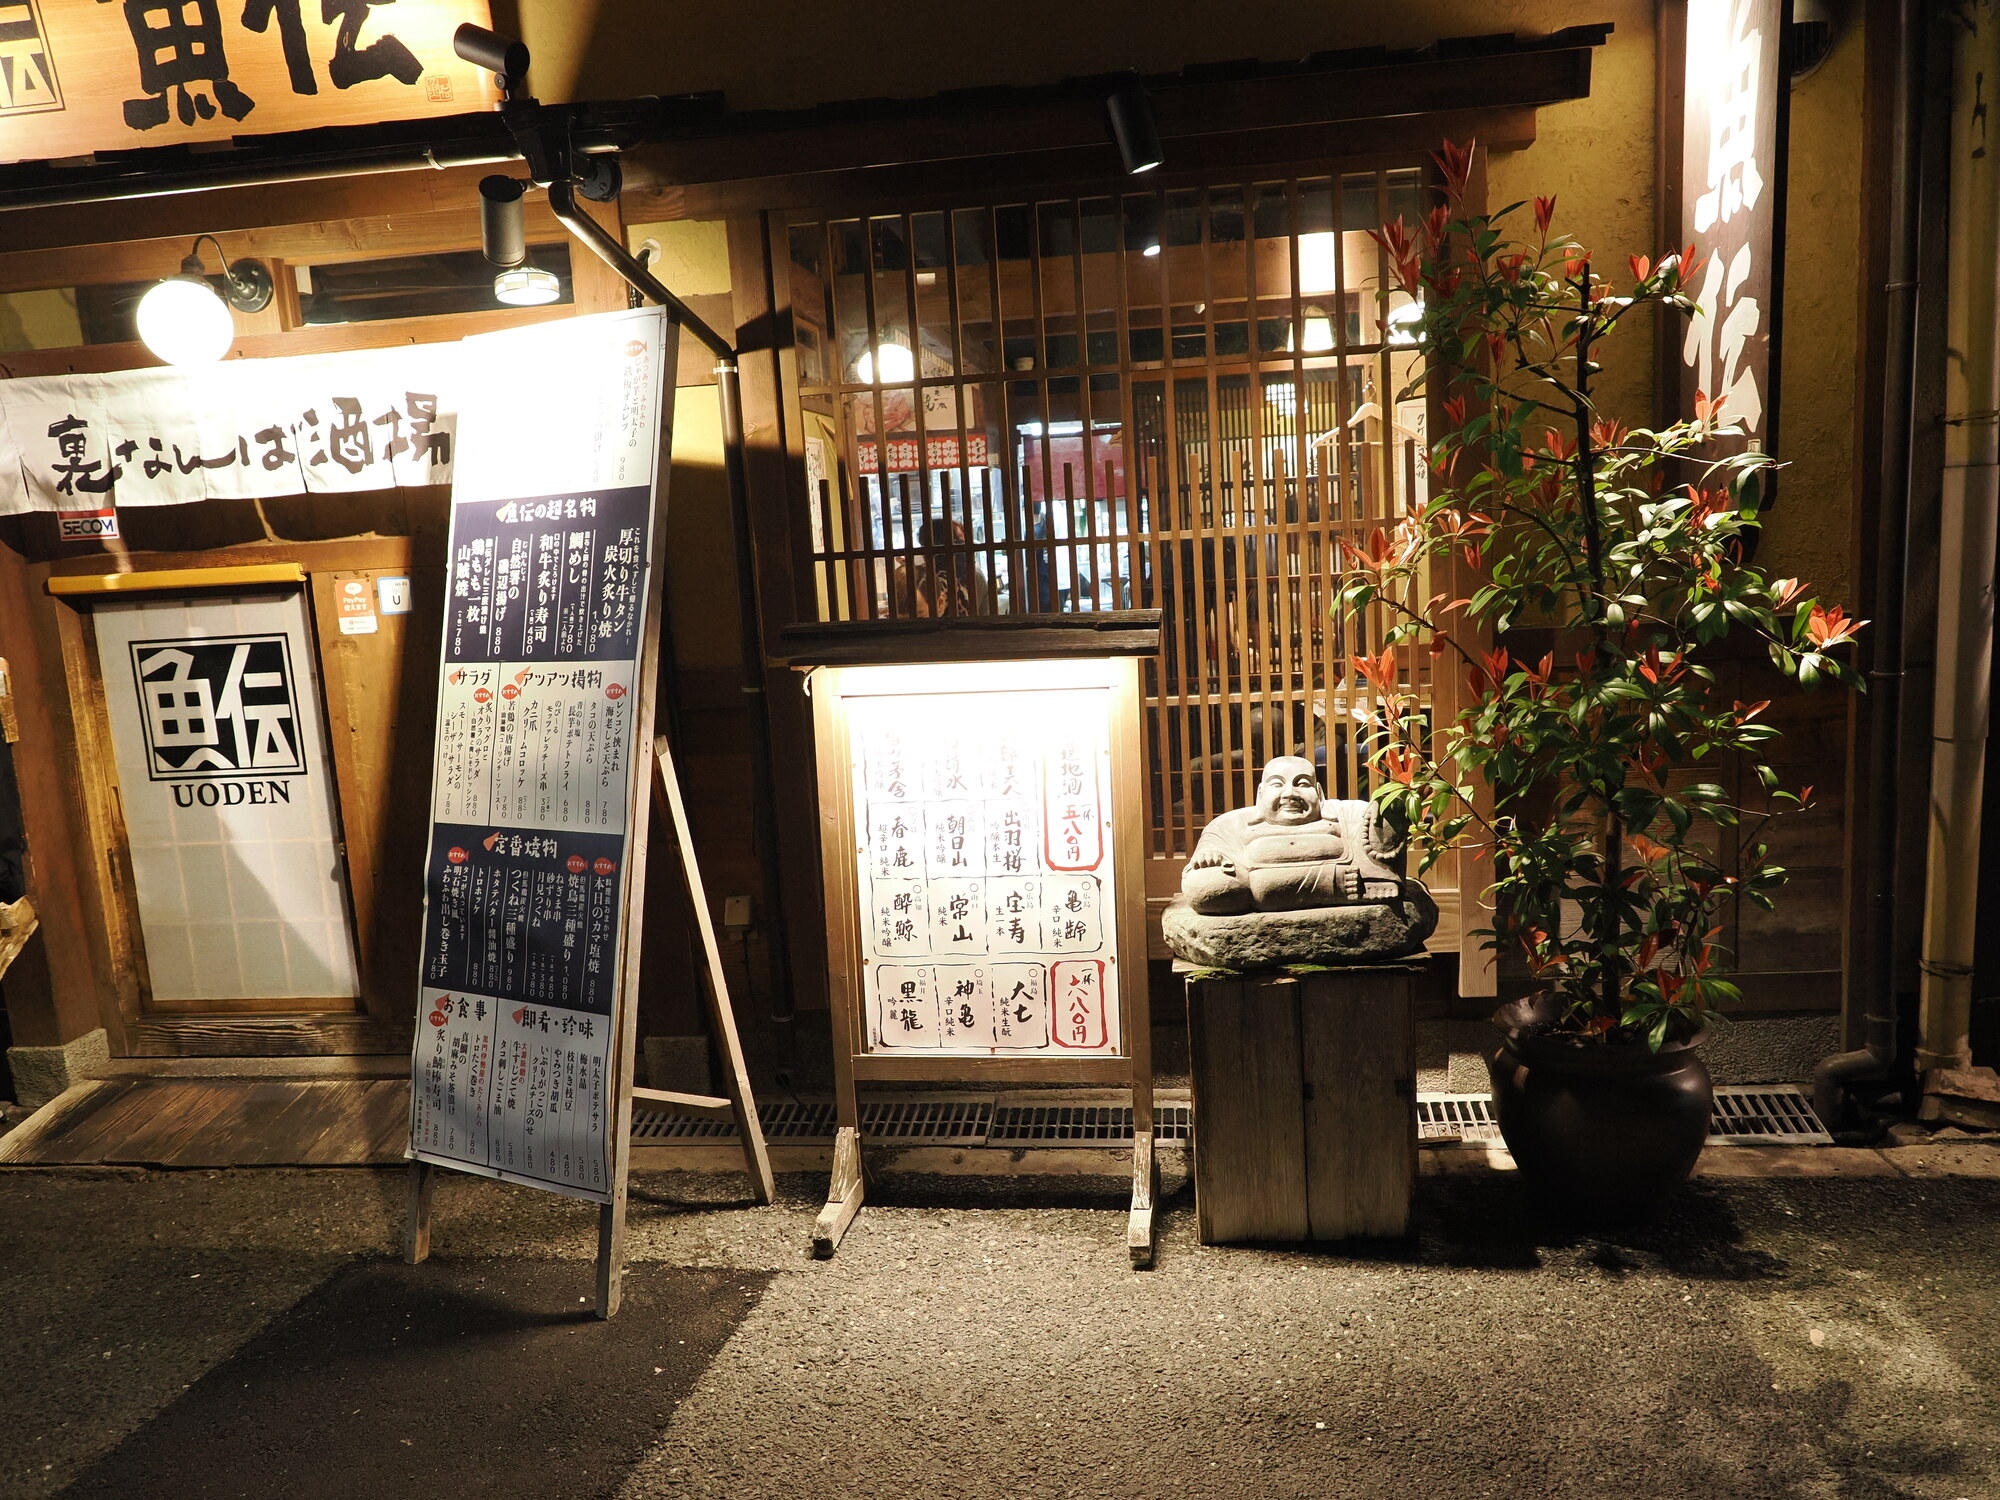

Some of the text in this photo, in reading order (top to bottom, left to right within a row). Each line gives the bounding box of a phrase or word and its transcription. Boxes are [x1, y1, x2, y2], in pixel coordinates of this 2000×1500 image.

[47, 391, 450, 496] 裏なんば酒場
[618, 456, 626, 480] 980
[62, 519, 115, 536] SECOM
[504, 498, 597, 524] 魚伝の超名物
[455, 544, 470, 597] 山賊焼
[466, 538, 485, 623] 鶏もも一枚
[508, 538, 522, 600] 自然薯の
[520, 540, 528, 582] じねんじょ
[551, 533, 560, 601] 口の中でとろけます
[568, 532, 584, 584] 鯛めし
[614, 528, 634, 632] 厚切り牛タン
[342, 596, 366, 604] PayPay
[494, 558, 510, 654] 磯辺揚げ 880
[534, 534, 554, 642] 和牛炙り寿司
[598, 544, 618, 638] 炭火炙り焼
[454, 628, 462, 656] 780
[526, 626, 534, 654] 480
[566, 624, 574, 653] 780
[457, 669, 492, 686] サラダ
[522, 669, 603, 690] アツアツ揚物
[473, 706, 485, 780] オクラのサラダ
[482, 702, 493, 762] 炙りマグロと
[504, 700, 516, 767] 若鶏の唐揚げ
[528, 700, 538, 732] カニ爪
[574, 701, 584, 737] 青のり塩
[586, 701, 597, 764] タコの天ぷら
[611, 701, 624, 772] レンコン挟まれ
[446, 712, 458, 787] シーザーサラダ
[454, 702, 466, 790] スモークサーモンの
[517, 706, 530, 788] クリームコロッケ
[539, 705, 553, 792] モッツァレラチーズ串
[562, 706, 576, 792] 長芋ポテトフライ
[601, 706, 614, 788] 海老しそ天ぷら
[170, 780, 291, 808] UODEN
[494, 834, 558, 859] 定番焼物
[891, 815, 914, 868] 春鹿
[936, 822, 946, 864] 純米吟醸
[946, 815, 968, 867] 朝日山
[1002, 810, 1026, 873] 出羽桜
[451, 866, 463, 919] 明石焼き風
[459, 866, 470, 941] タコが入っています
[472, 867, 484, 915] トロホッケ
[487, 869, 502, 963] ホタテバター醤油焼
[506, 869, 522, 964] つくね三種盛り
[532, 871, 545, 928] 月見つくね
[543, 872, 556, 921] 砂ずり串
[552, 873, 564, 922] ねぎま串
[562, 874, 580, 962] 焼鳥三種盛り
[894, 892, 918, 942] 酔鯨
[937, 906, 948, 927] 純米
[950, 892, 974, 942] 常山
[1006, 890, 1026, 944] 宝寿
[436, 866, 452, 978] ふわふわ出し巻き玉子
[588, 876, 605, 1004] 本日のカマ塩焼 880
[880, 906, 892, 948] 純米吟醸
[996, 906, 1005, 937] 生一本
[443, 996, 487, 1022] お食事
[899, 981, 924, 1032] 黒龍
[944, 996, 956, 1038] 辛口純米
[954, 979, 976, 1029] 神亀
[1010, 980, 1035, 1024] 大七
[448, 1036, 461, 1117] 胡麻みそ茶漬け
[458, 1032, 470, 1065] 真鯛の
[469, 1034, 481, 1098] トロたく巻き
[506, 1040, 521, 1110] 牛すじどて焼
[493, 1040, 507, 1116] タコ刺しごま油
[526, 1056, 539, 1136] クリームチーズのせ
[534, 1045, 549, 1120] いぶりがっこの
[550, 1048, 562, 1114] やみつき胡瓜
[564, 1050, 576, 1112] 枝付き枝豆
[592, 1055, 602, 1132] 明太子ポテサラ
